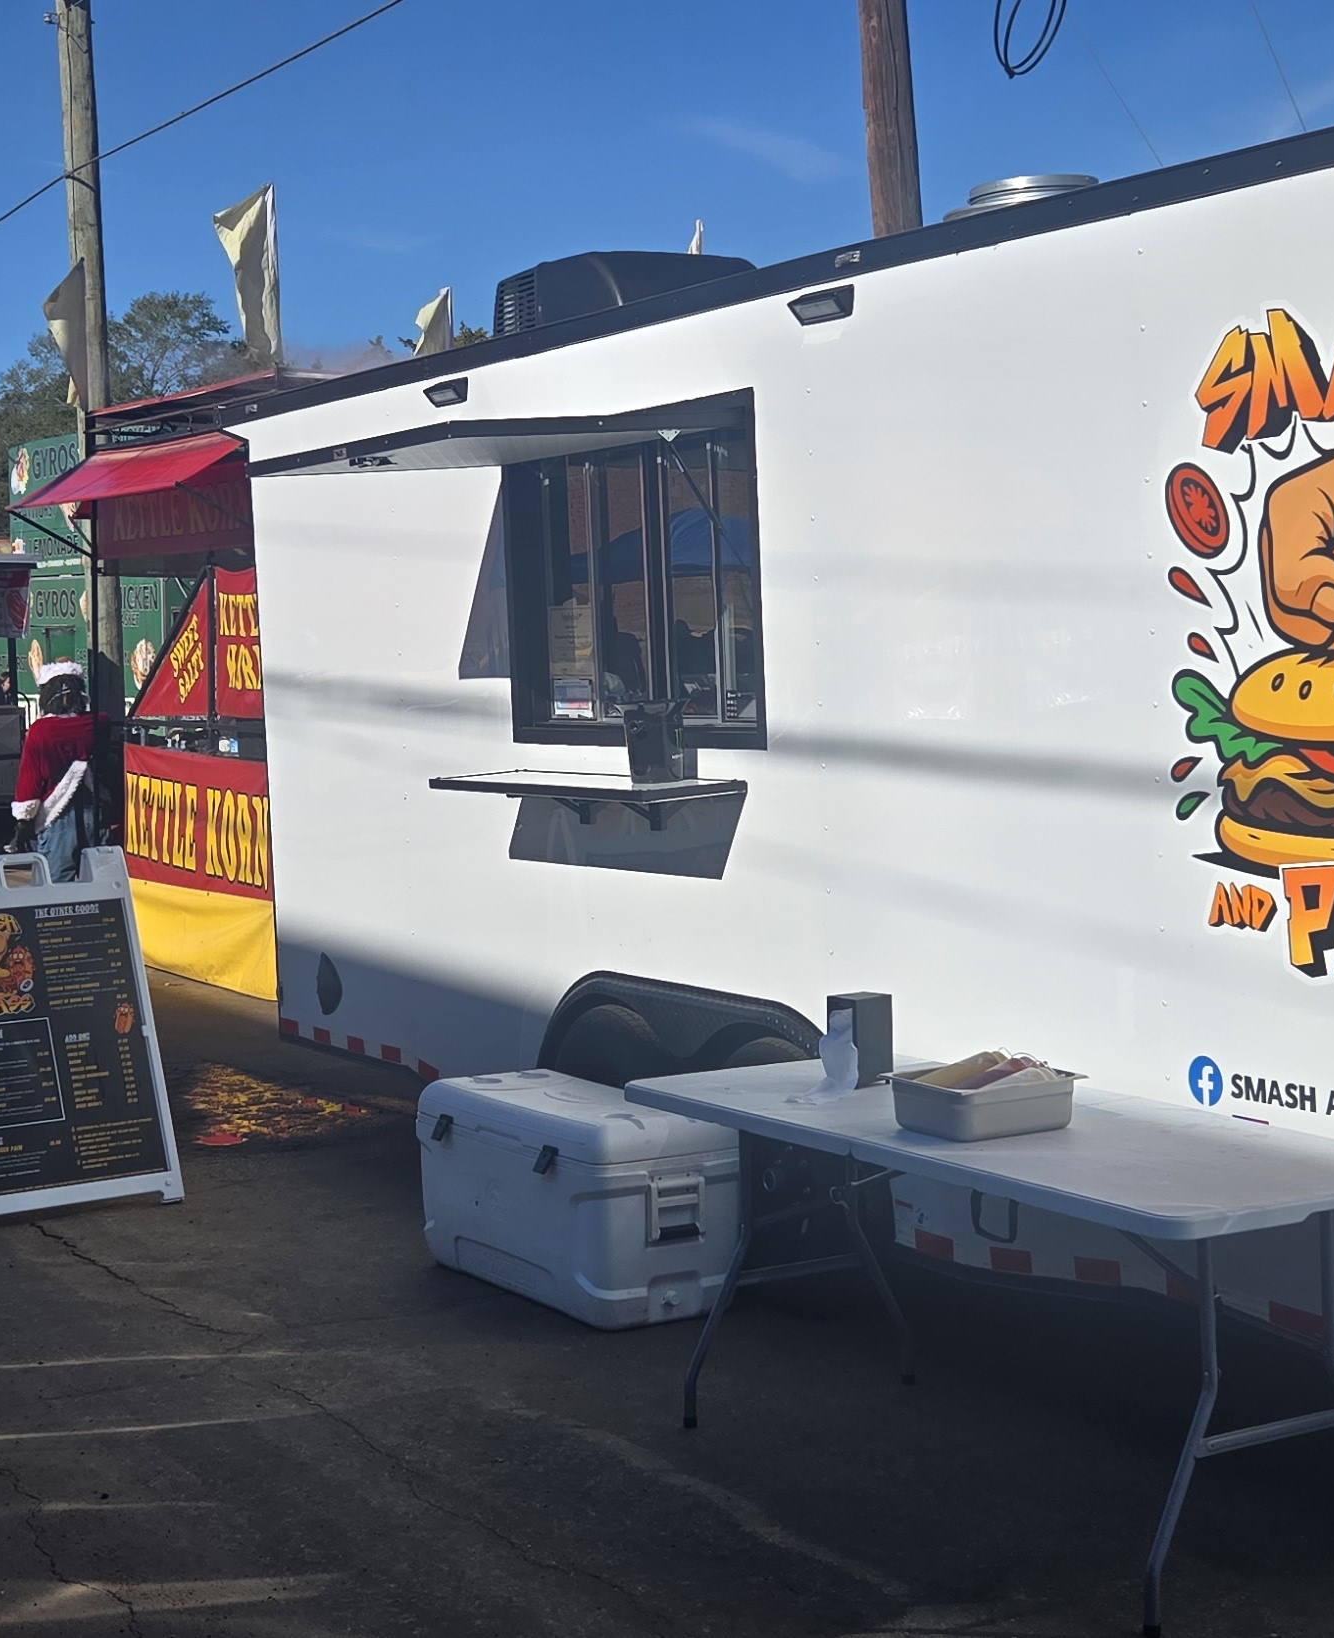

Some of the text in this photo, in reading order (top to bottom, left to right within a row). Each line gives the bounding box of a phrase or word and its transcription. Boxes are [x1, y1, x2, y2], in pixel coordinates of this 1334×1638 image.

[32, 443, 77, 480] GYROS
[113, 489, 184, 541] KETTLE
[35, 588, 77, 618] GYROS
[121, 582, 159, 611] ICKEN
[169, 614, 199, 678] SWEET
[178, 642, 204, 703] SALTY
[126, 771, 269, 891] KETTLE KORN
[34, 907, 48, 918] THE
[50, 905, 73, 916] OTHER
[1208, 881, 1278, 932] AND
[1231, 1073, 1316, 1113] SMASH
